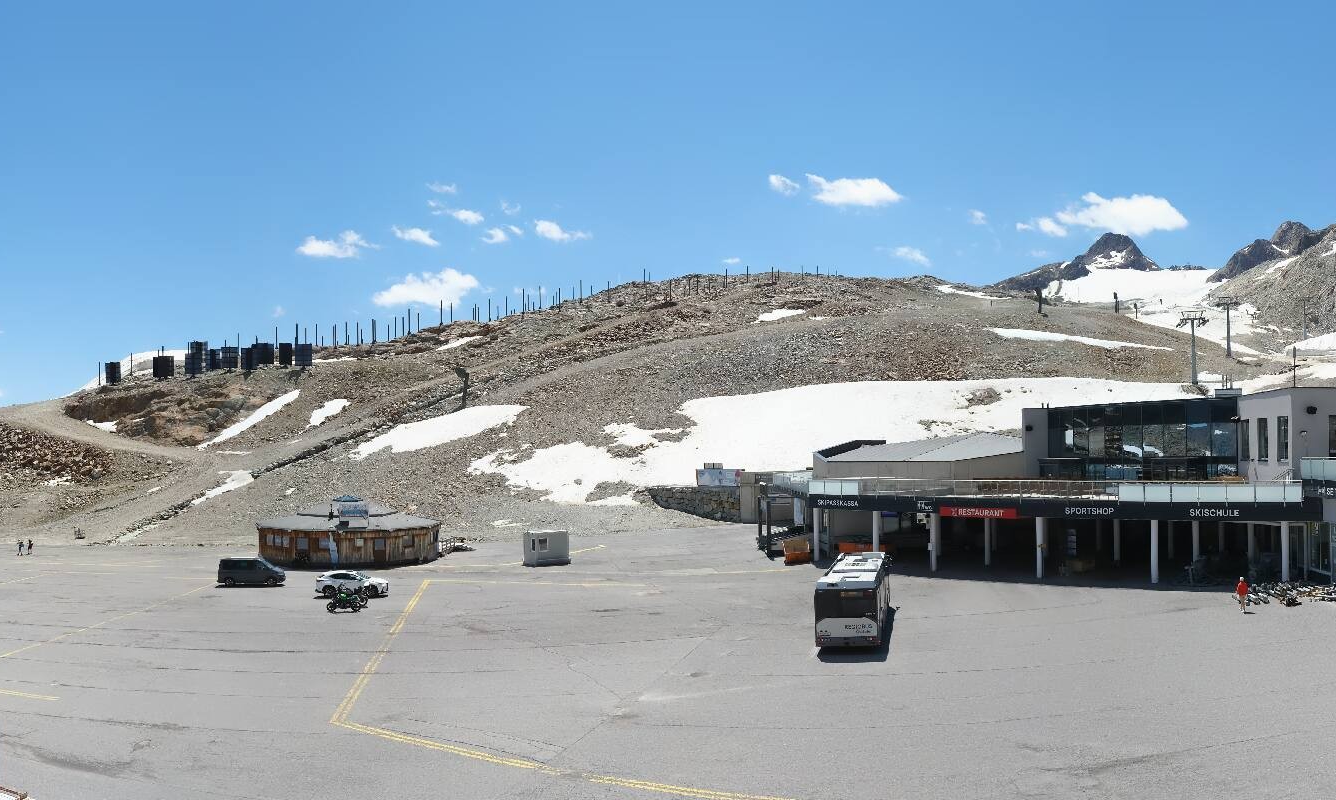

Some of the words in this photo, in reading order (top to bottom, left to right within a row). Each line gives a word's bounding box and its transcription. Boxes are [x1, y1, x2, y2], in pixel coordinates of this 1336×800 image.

[958, 508, 1005, 517] RESTAURANT
[1065, 507, 1115, 515] SPORTSHOP
[1189, 508, 1240, 517] SKISCHULE
